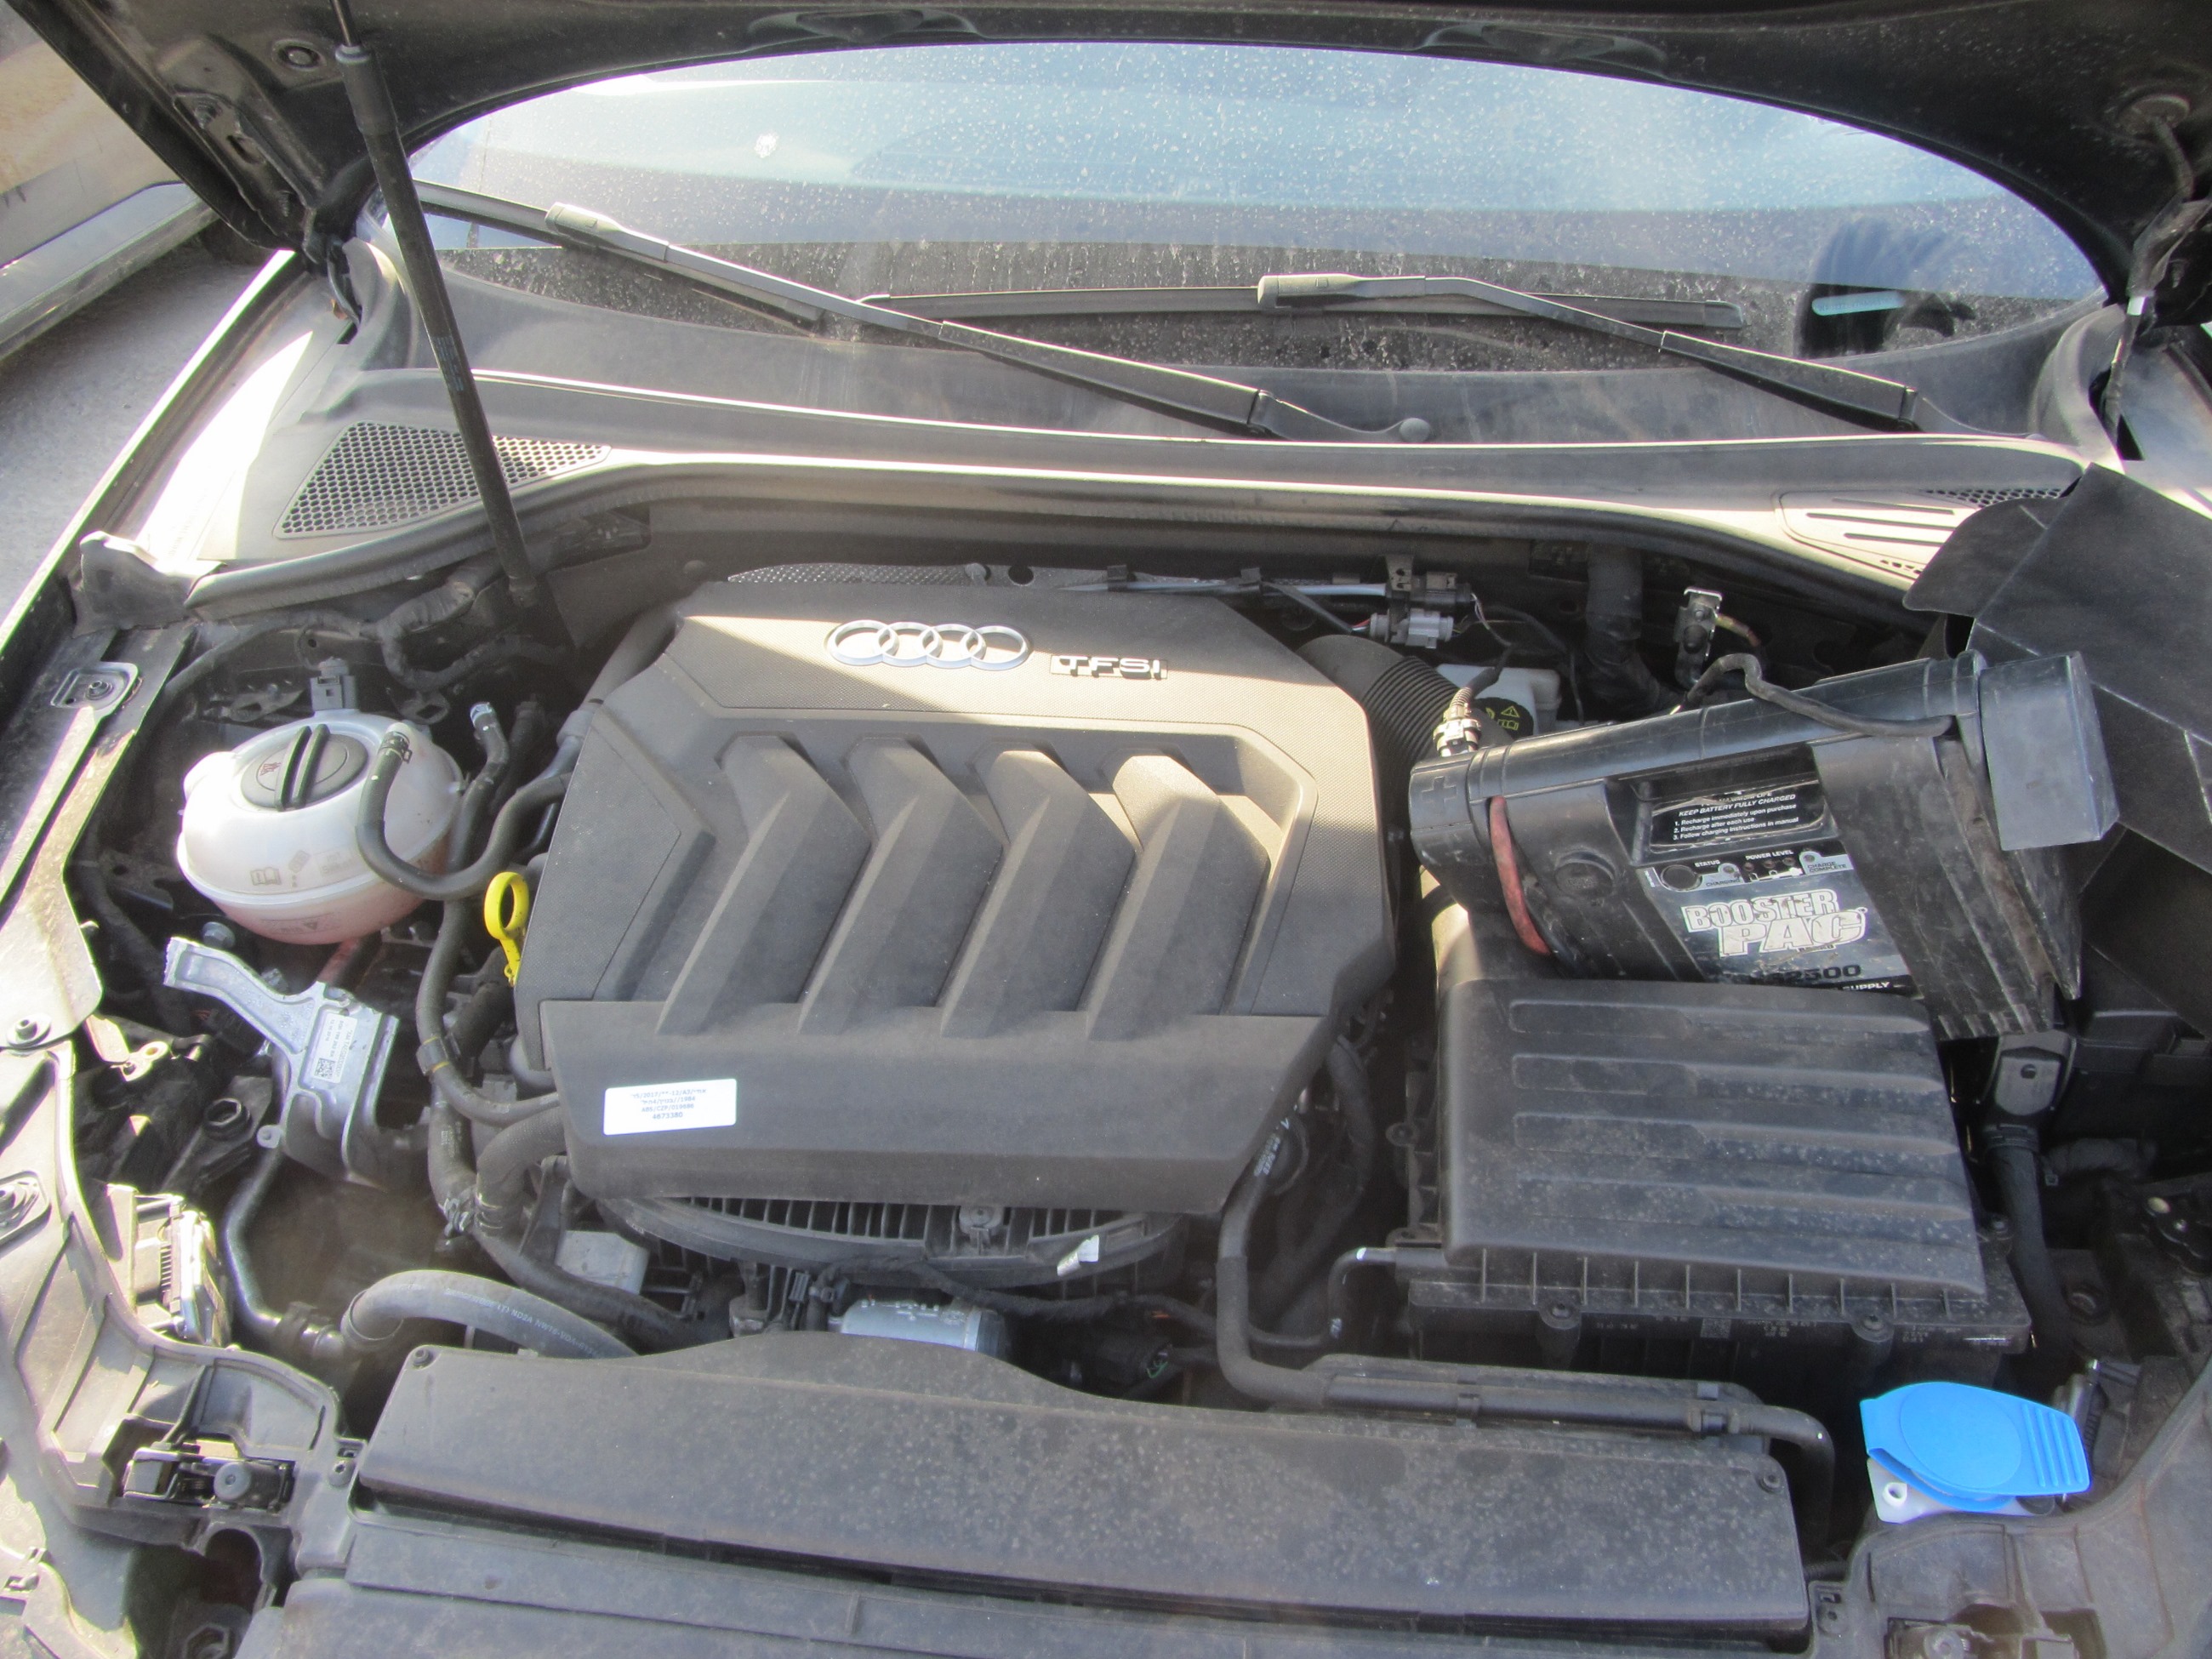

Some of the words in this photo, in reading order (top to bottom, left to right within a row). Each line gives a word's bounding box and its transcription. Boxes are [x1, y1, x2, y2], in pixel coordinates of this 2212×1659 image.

[1058, 655, 1161, 677] TFSI
[1680, 816, 1710, 826] Recharge
[1711, 810, 1748, 822] immediately
[1750, 808, 1766, 817] upon
[1766, 803, 1797, 814] purchase
[1699, 803, 1733, 814] BATTERY
[1733, 799, 1757, 809] FULLY
[1758, 794, 1796, 805] CHARGED
[1679, 831, 1701, 840] Follow
[1701, 828, 1729, 837] charging
[1729, 822, 1767, 832] instructions
[1774, 816, 1799, 825] manual
[1680, 823, 1710, 833] Recharge
[1745, 852, 1772, 860] POWER
[1809, 864, 1847, 873] COMPLETE
[1681, 889, 1839, 932] BOOSTER
[1719, 910, 1866, 958] PAC
